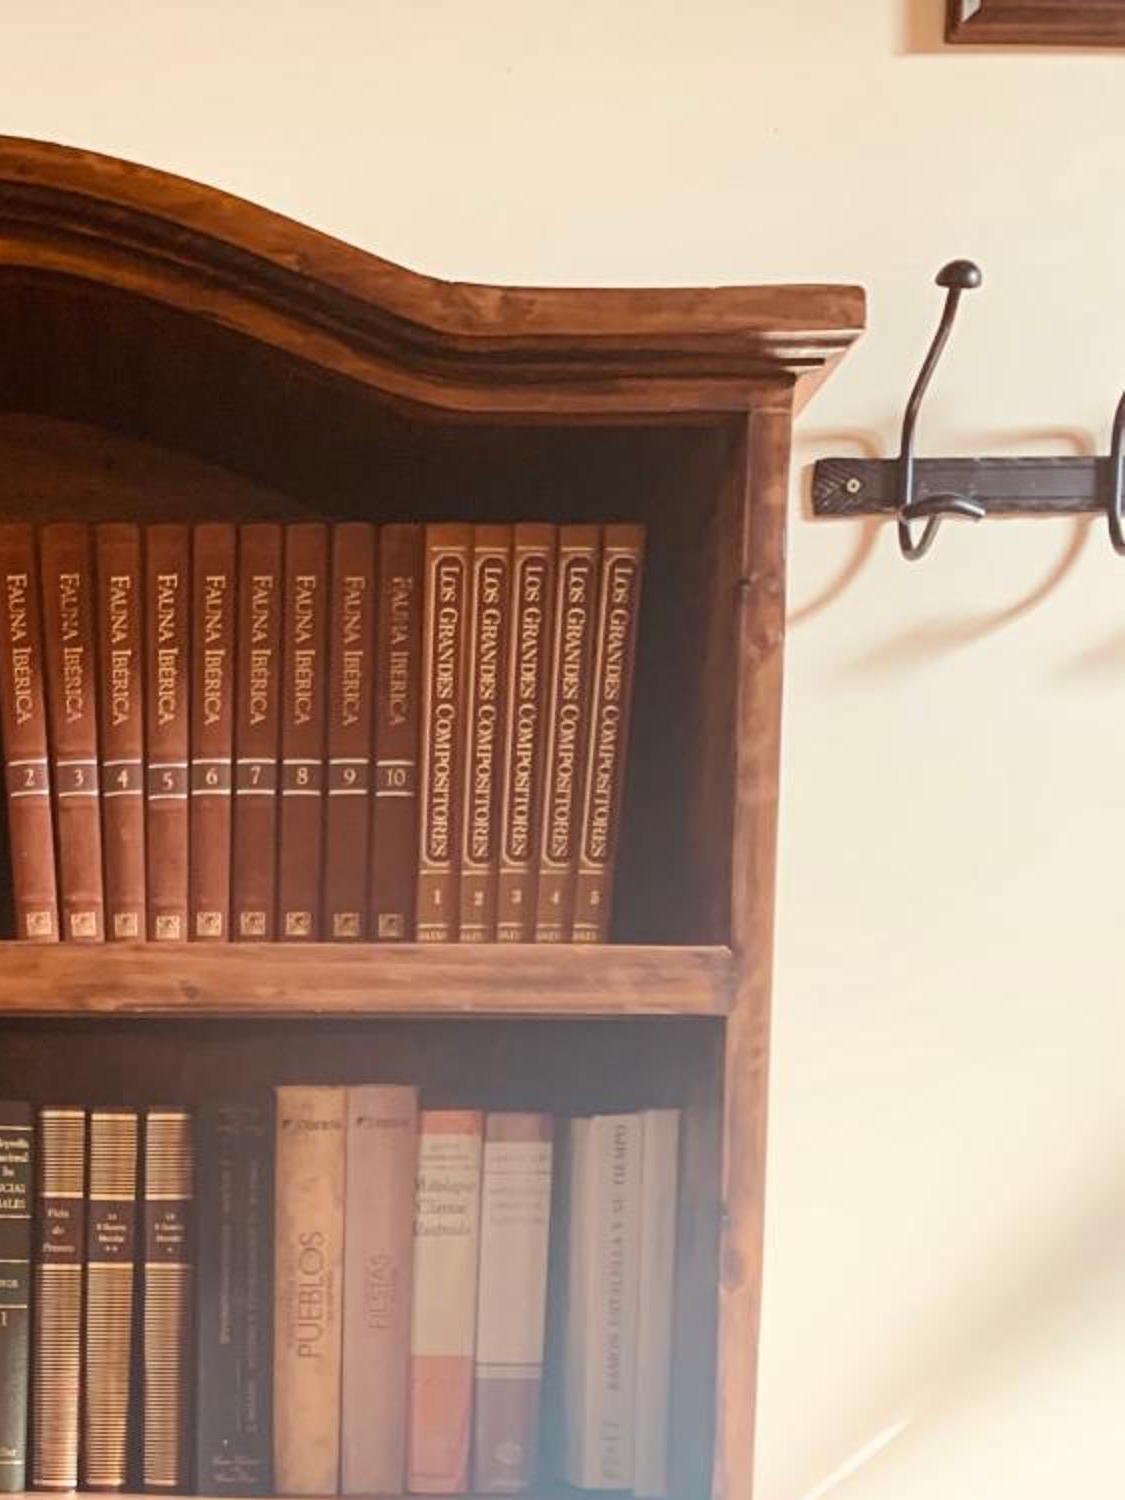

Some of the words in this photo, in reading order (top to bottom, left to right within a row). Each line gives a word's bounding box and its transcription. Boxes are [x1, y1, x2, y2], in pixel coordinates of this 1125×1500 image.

[7, 574, 31, 641] FAUNA
[59, 573, 80, 641] FAUNA
[111, 575, 130, 643] FAUNA
[158, 575, 178, 643] FAUNA
[206, 575, 225, 642] FAUNA
[251, 575, 272, 643] FAUNA
[296, 575, 315, 643] FAUNA
[344, 576, 365, 644] FAUNA
[441, 566, 459, 602] LOS
[484, 567, 502, 603] LOS
[525, 567, 543, 602] LOS
[569, 567, 588, 603] LOS
[613, 567, 632, 603] LOS
[437, 607, 458, 699] GRANDES
[479, 609, 501, 700] GRANDES
[520, 608, 541, 699] GRANDES
[563, 609, 586, 700] GRANDES
[605, 610, 627, 700] GRANDES
[24, 769, 35, 786] 2
[75, 769, 84, 785] 3
[117, 772, 128, 787] 4
[163, 774, 173, 788] 5
[206, 769, 218, 785] 6
[251, 767, 261, 784] 7
[297, 769, 308, 785] 8
[344, 770, 355, 785] 9
[386, 769, 405, 786] 10
[431, 704, 455, 856] COMPOSITORES
[474, 704, 496, 857] COMPOSITORES
[512, 704, 537, 855] COMPOSITORES
[553, 704, 579, 856] COMPOSITORES
[591, 705, 619, 857] COMPOSITORES
[434, 889, 441, 904] 1
[297, 1231, 323, 1360] PUEBLOS
